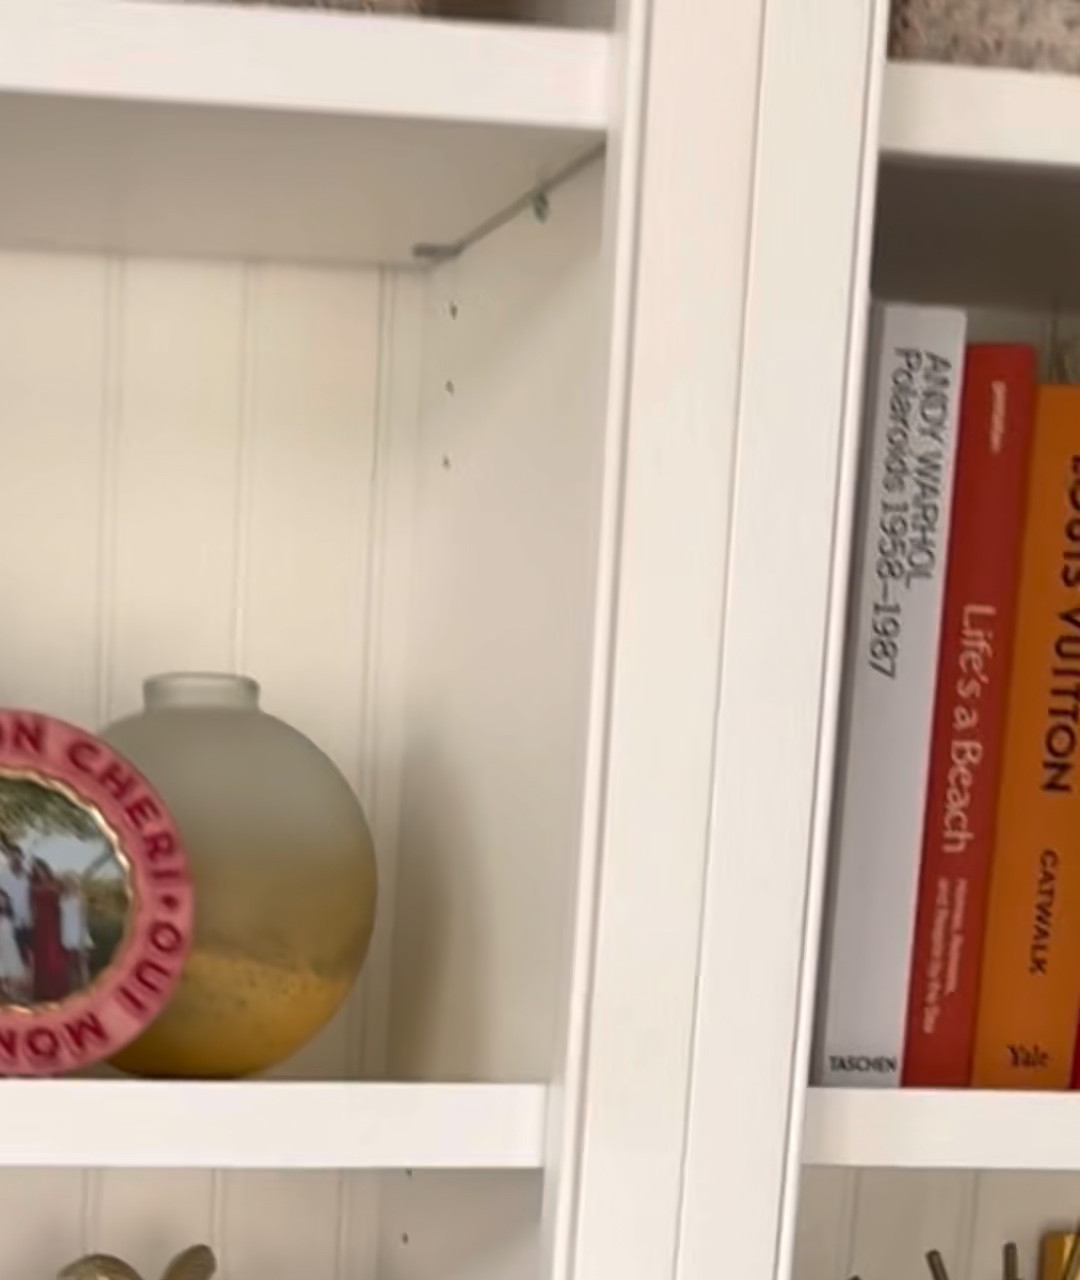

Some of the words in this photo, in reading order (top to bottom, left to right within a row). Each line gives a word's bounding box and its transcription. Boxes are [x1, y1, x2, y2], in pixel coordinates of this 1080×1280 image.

[882, 347, 925, 493] Polaroids
[905, 451, 945, 590] WARHOL
[953, 704, 981, 731] a
[66, 738, 185, 886] CHERI
[942, 741, 984, 854] Beach
[1028, 849, 1060, 976] CATWALK
[120, 932, 187, 1016] OUI
[1007, 1044, 1054, 1071] Yale
